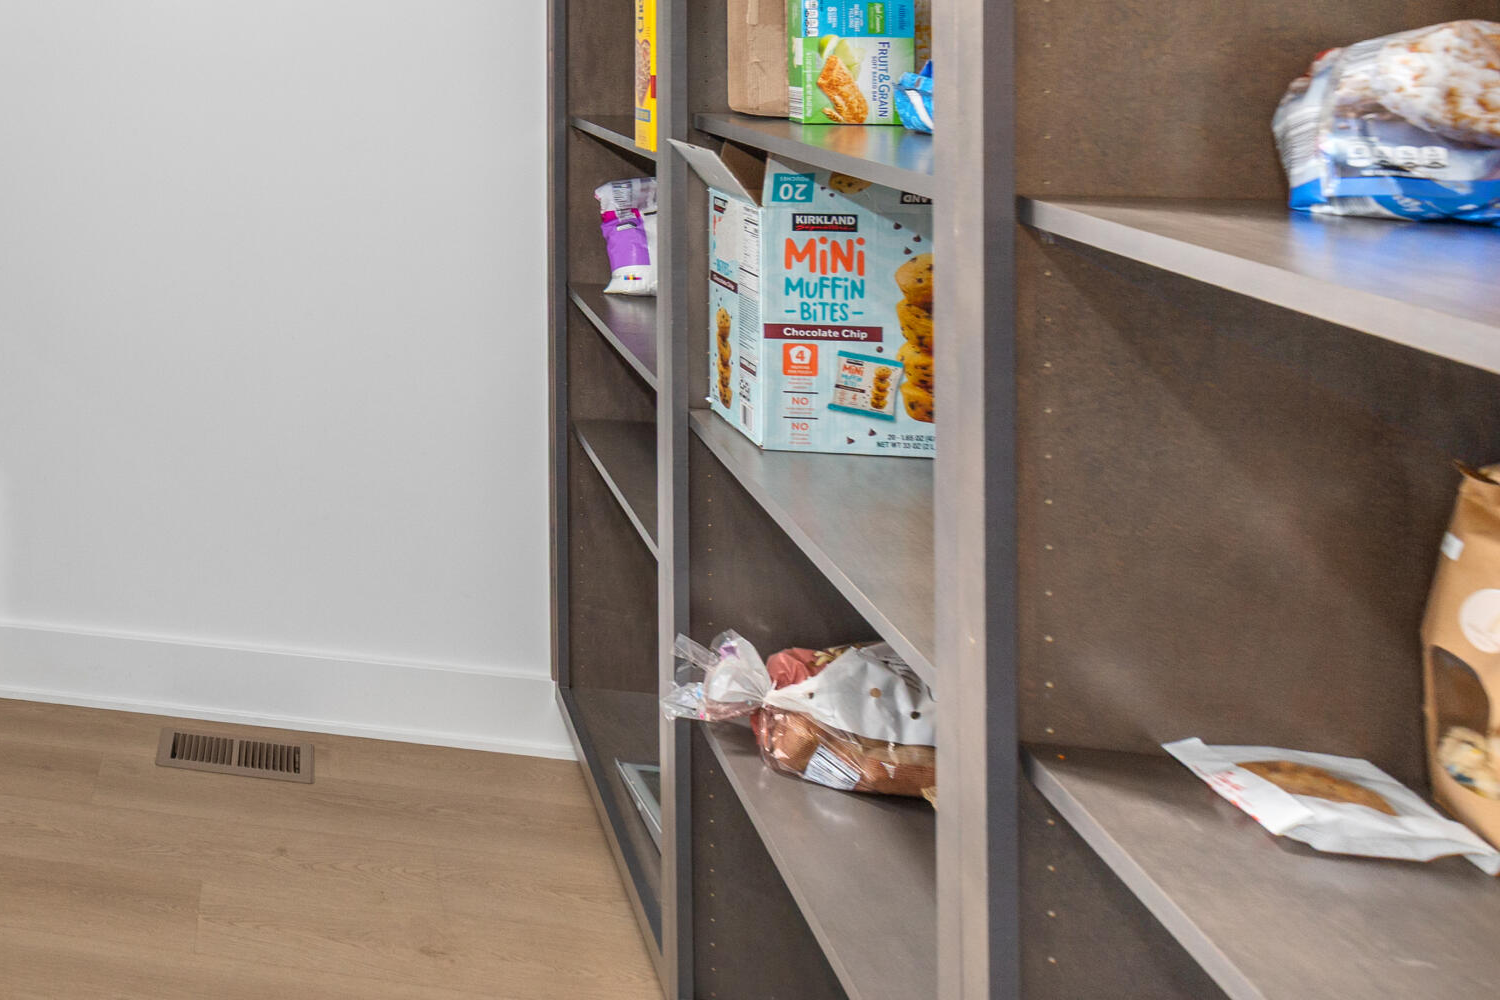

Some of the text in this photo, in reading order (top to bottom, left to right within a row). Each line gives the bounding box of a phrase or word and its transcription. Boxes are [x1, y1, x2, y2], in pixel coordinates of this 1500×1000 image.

[779, 183, 808, 201] 20
[795, 214, 856, 226] KIRKLAND
[783, 327, 868, 340] Chocolate Chip
[795, 350, 805, 362] 4
[791, 396, 809, 406] NO
[791, 422, 809, 431] NO
